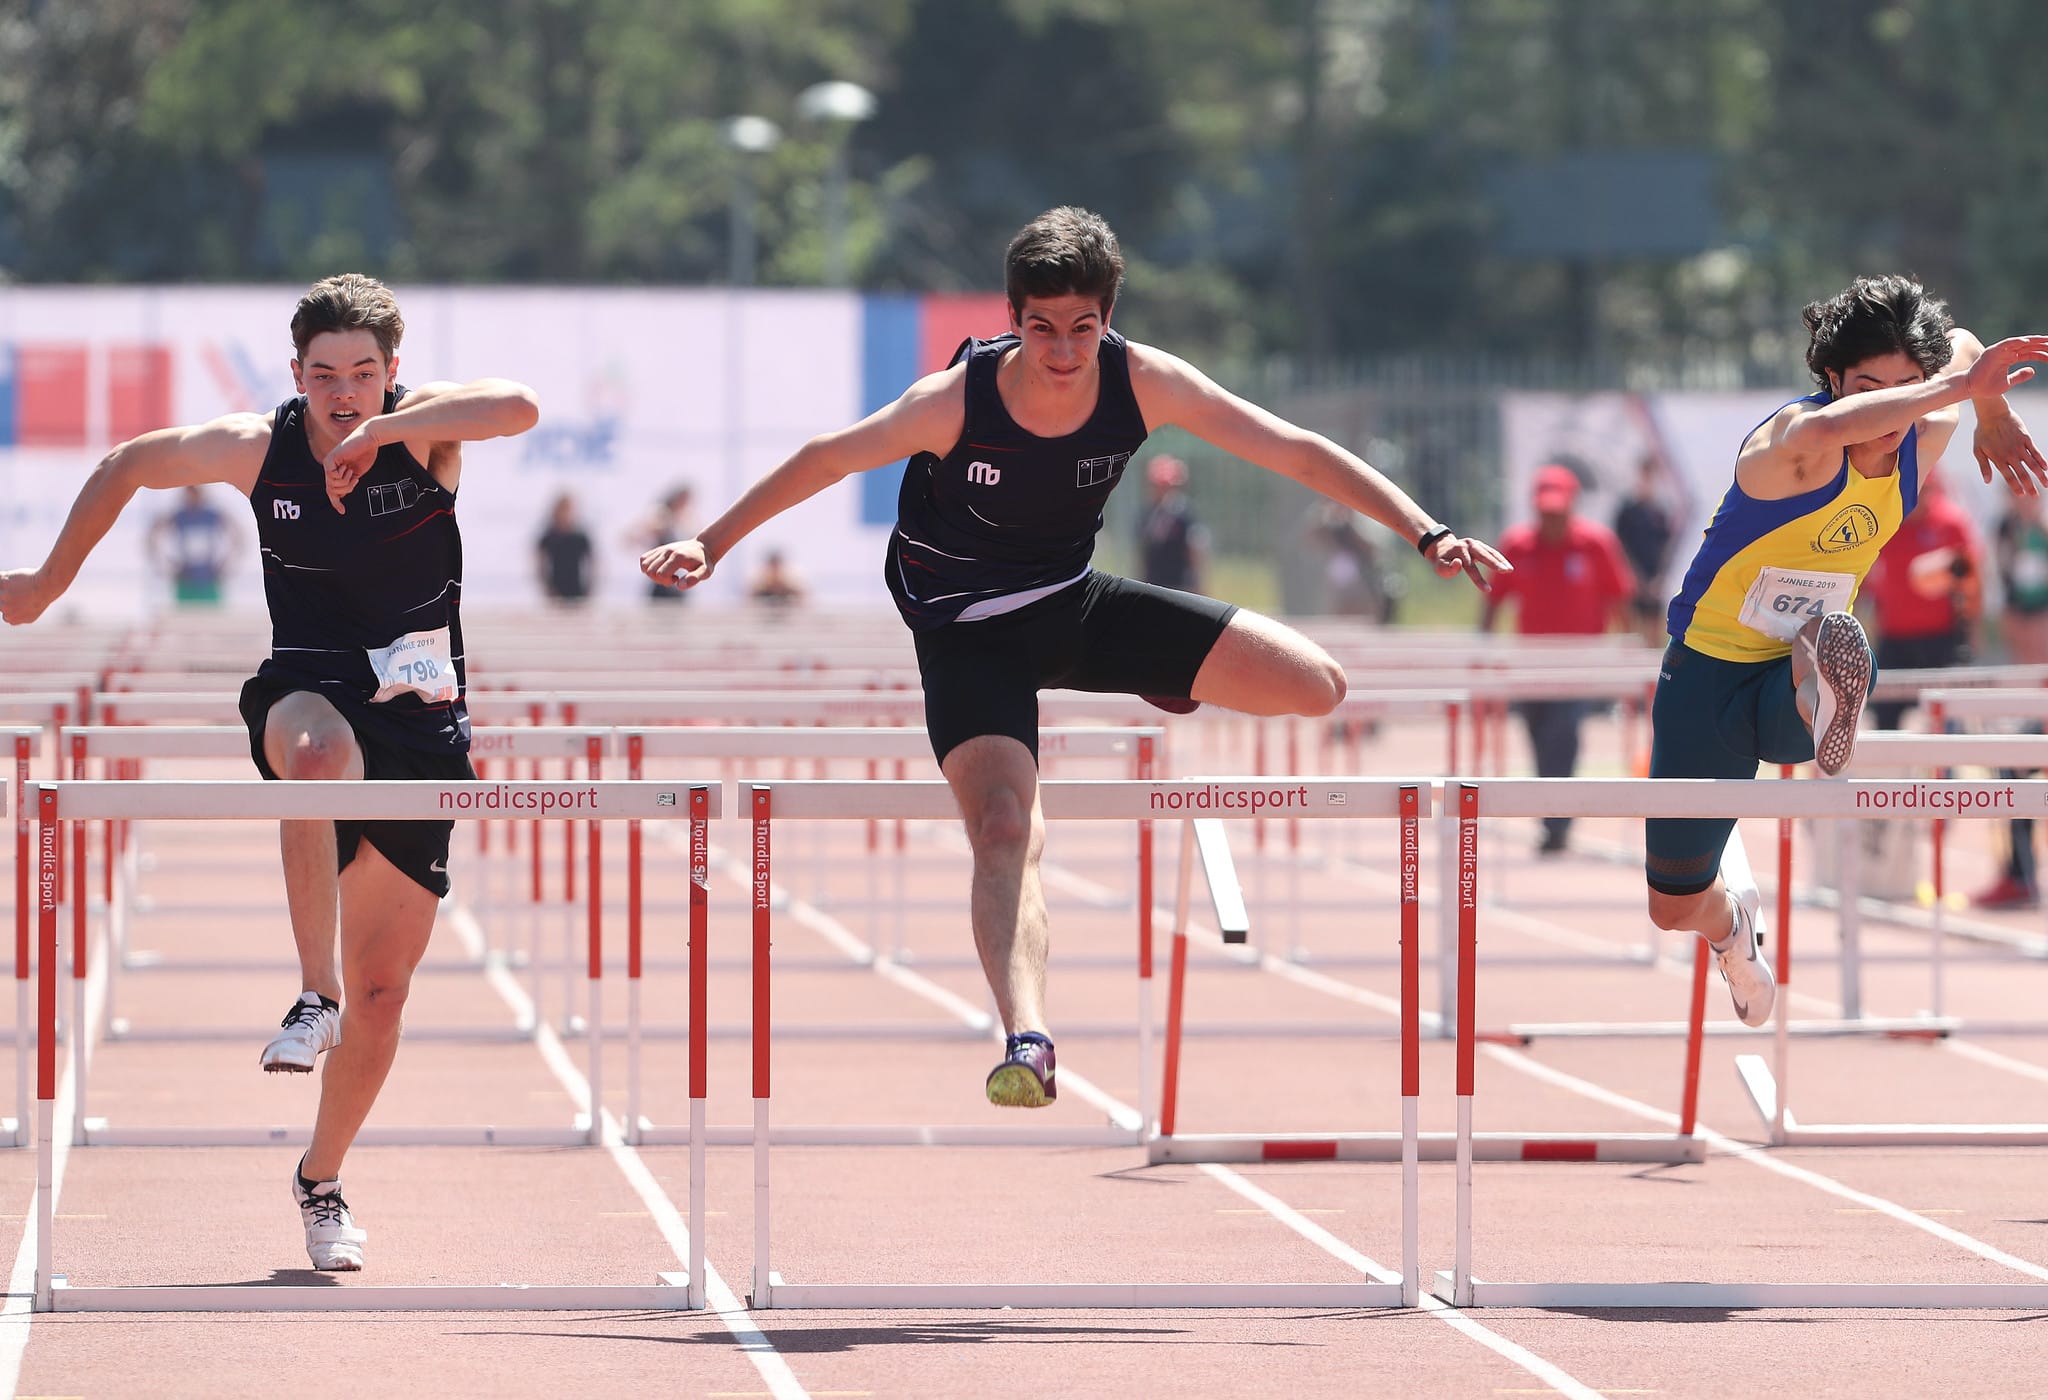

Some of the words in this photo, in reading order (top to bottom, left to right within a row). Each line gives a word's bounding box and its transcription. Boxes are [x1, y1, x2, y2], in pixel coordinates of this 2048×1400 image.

[1777, 577, 1815, 588] JJNNEE
[1815, 581, 1836, 589] 2019
[1772, 594, 1825, 617] 674
[416, 637, 435, 648] 2019
[398, 658, 439, 685] 798
[439, 785, 598, 815] nordicsport
[1150, 785, 1308, 814] nordicsport
[1856, 784, 2014, 814] nordicsport
[40, 872, 56, 911] Sport
[754, 871, 769, 909] Sport
